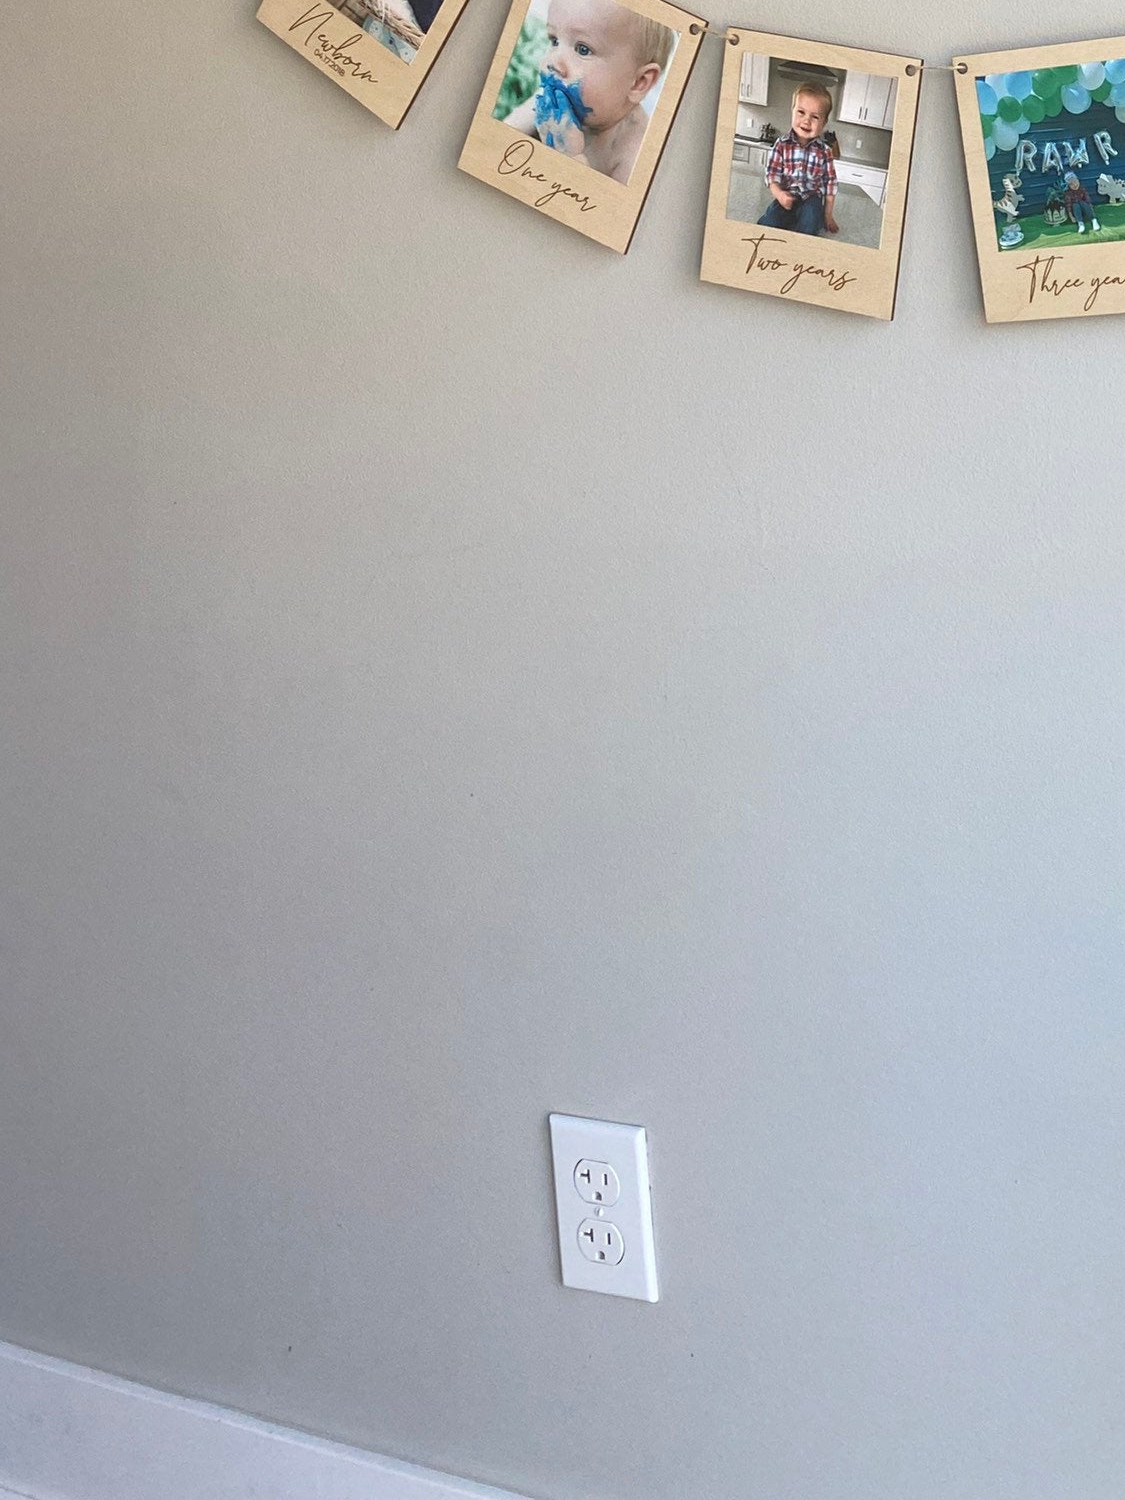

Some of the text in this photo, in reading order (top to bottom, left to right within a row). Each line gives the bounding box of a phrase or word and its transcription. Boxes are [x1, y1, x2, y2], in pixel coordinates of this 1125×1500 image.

[288, 2, 379, 83] Newborn
[497, 139, 598, 212] One year
[1014, 129, 1118, 176] RAWR
[741, 233, 858, 295] Two years
[1015, 254, 1085, 304] Three
